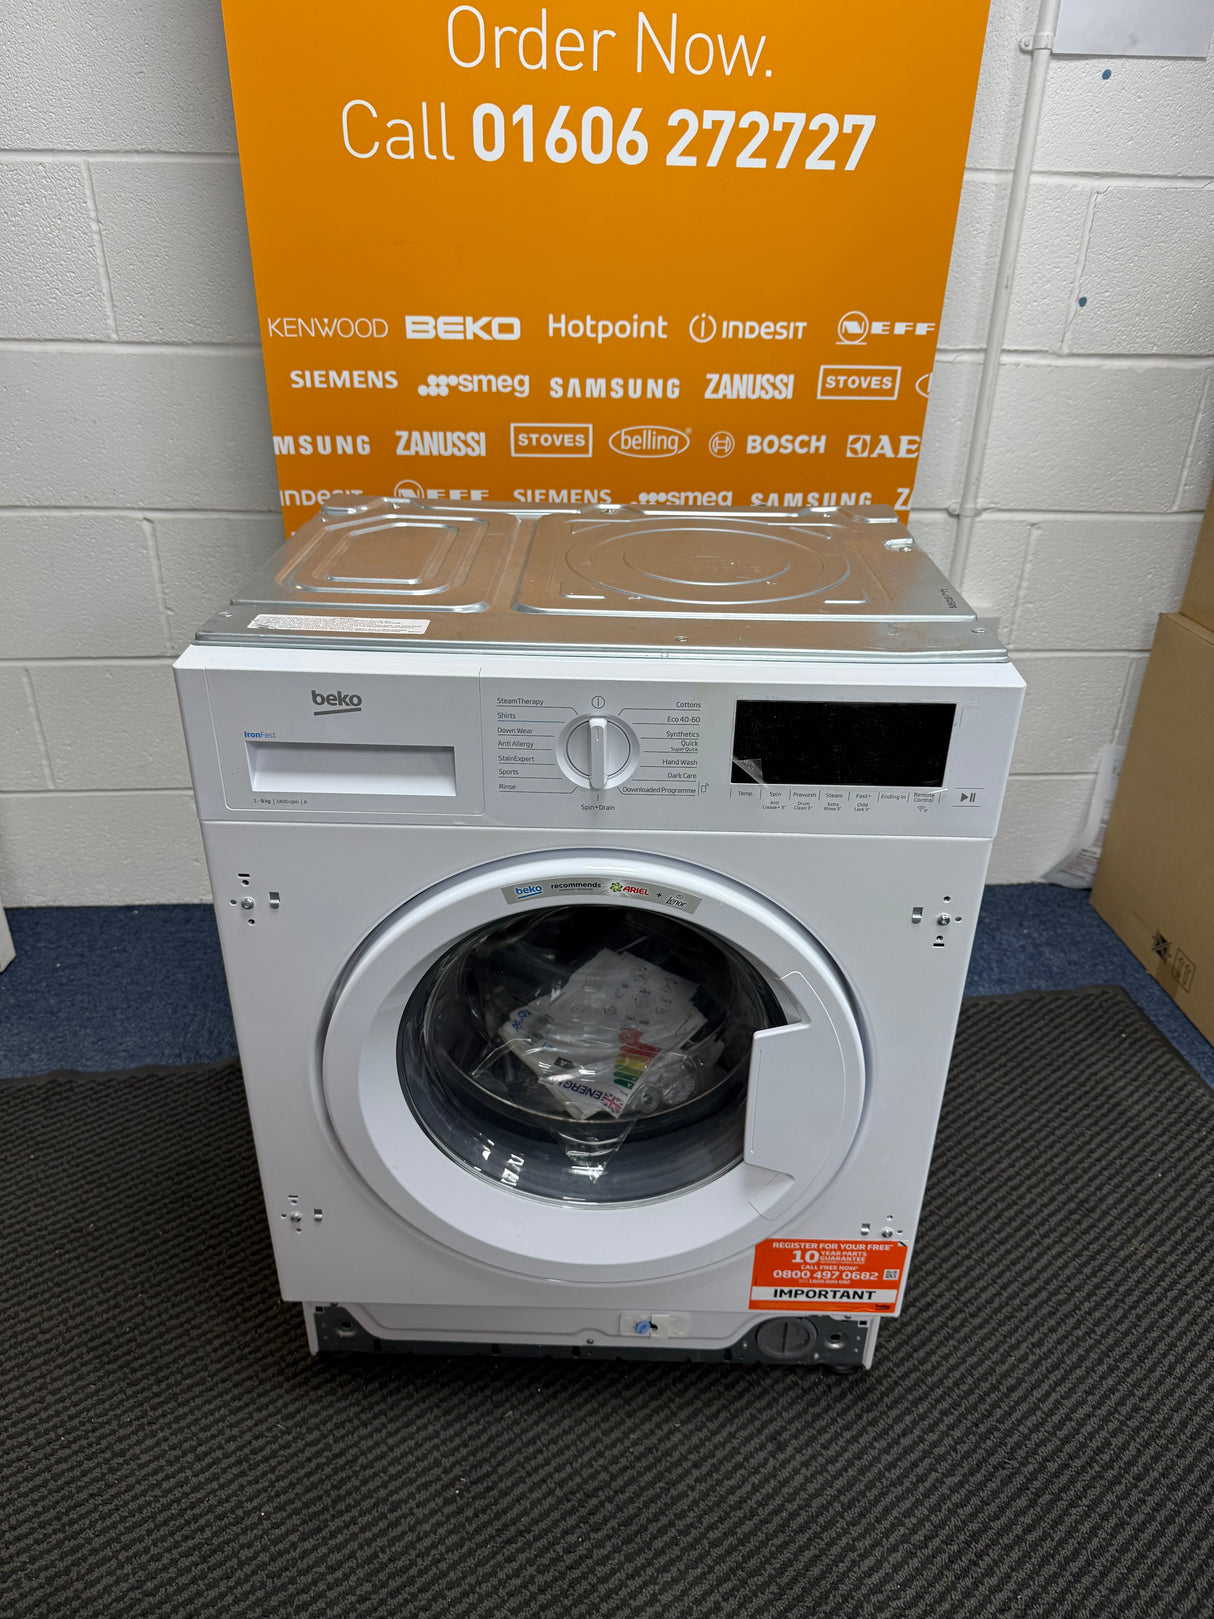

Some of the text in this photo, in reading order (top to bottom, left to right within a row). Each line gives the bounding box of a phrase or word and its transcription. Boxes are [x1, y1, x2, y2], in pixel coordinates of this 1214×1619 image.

[446, 5, 774, 78] Order Now.
[340, 99, 877, 171] Call 01606 272727
[267, 317, 389, 338] KENWOOD
[404, 315, 521, 341] BEKO
[548, 314, 669, 344] Hotpoint
[289, 370, 399, 389] SIEMENS
[825, 375, 893, 390] STOVES
[458, 373, 530, 398] smeg
[549, 377, 681, 400] SAMSUNG
[704, 373, 795, 400] ZANUSSI
[395, 430, 486, 457] ZANUSSI
[517, 433, 586, 448] STOVES
[620, 429, 679, 452] belling
[746, 435, 826, 454] BOSCH
[311, 690, 363, 707] beko
[496, 697, 544, 707] SteamTherapy
[675, 701, 702, 709] Cottons
[497, 712, 516, 720] Shirts
[243, 730, 277, 740] IronFast
[497, 727, 533, 735] Down Wear
[666, 730, 700, 739] Synthetics
[497, 740, 534, 750] Anti Allergy
[680, 740, 699, 748] Quick
[498, 755, 535, 764] StainExpert
[662, 758, 680, 766] Hand
[498, 768, 519, 777] Sports
[661, 787, 697, 795] Programme
[769, 791, 781, 799] Spin
[792, 791, 817, 799] Prewash
[855, 792, 872, 800] Fast+
[881, 793, 899, 801] Ending
[515, 884, 543, 896] beko
[550, 881, 602, 890] recommends
[622, 885, 650, 896] ARIEL
[772, 1241, 818, 1250] REGISTER
[819, 1242, 837, 1250] FOR
[839, 1243, 866, 1251] YOUR
[791, 1250, 820, 1264] 10
[772, 1270, 879, 1281] 0800 497 0682
[772, 1288, 877, 1300] IMPORTANT
